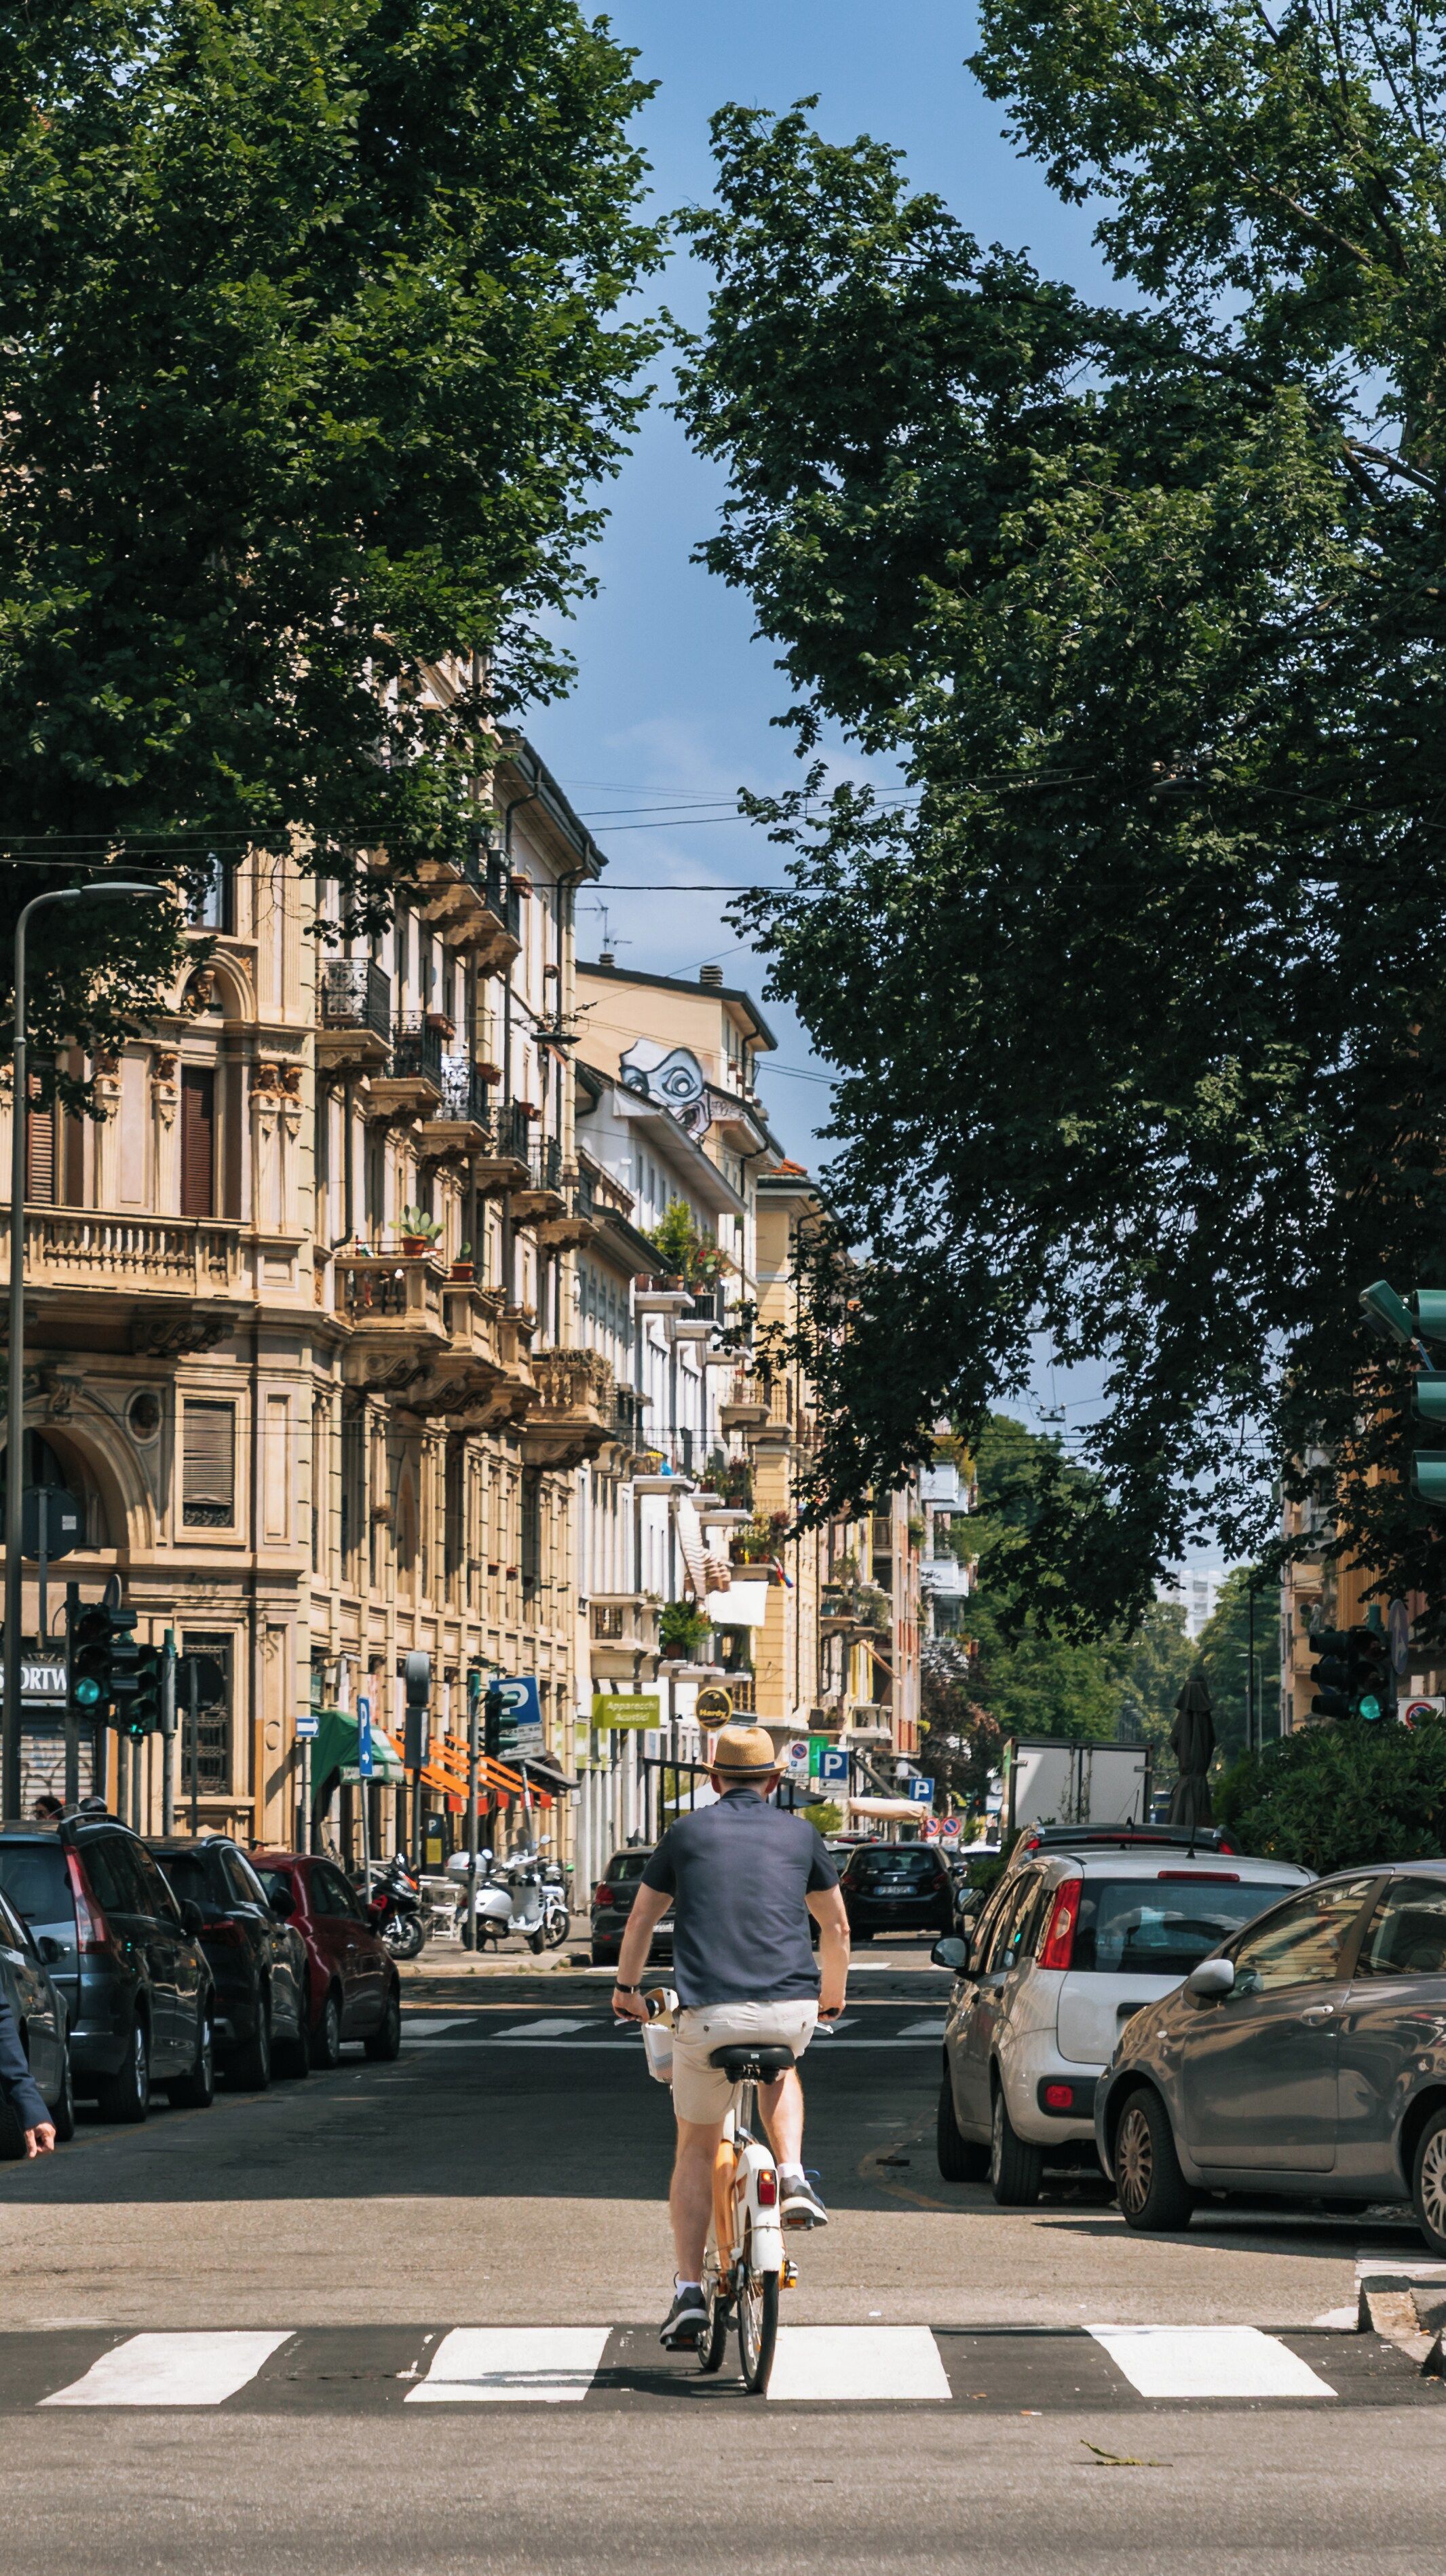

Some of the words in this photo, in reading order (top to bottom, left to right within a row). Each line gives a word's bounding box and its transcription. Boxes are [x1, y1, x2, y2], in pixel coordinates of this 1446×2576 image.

[499, 1683, 529, 1716] P
[607, 1701, 658, 1711] Apparecchi
[360, 1702, 367, 1739] P
[824, 1754, 843, 1777] P
[915, 1781, 930, 1799] P
[428, 1819, 436, 1832] P
